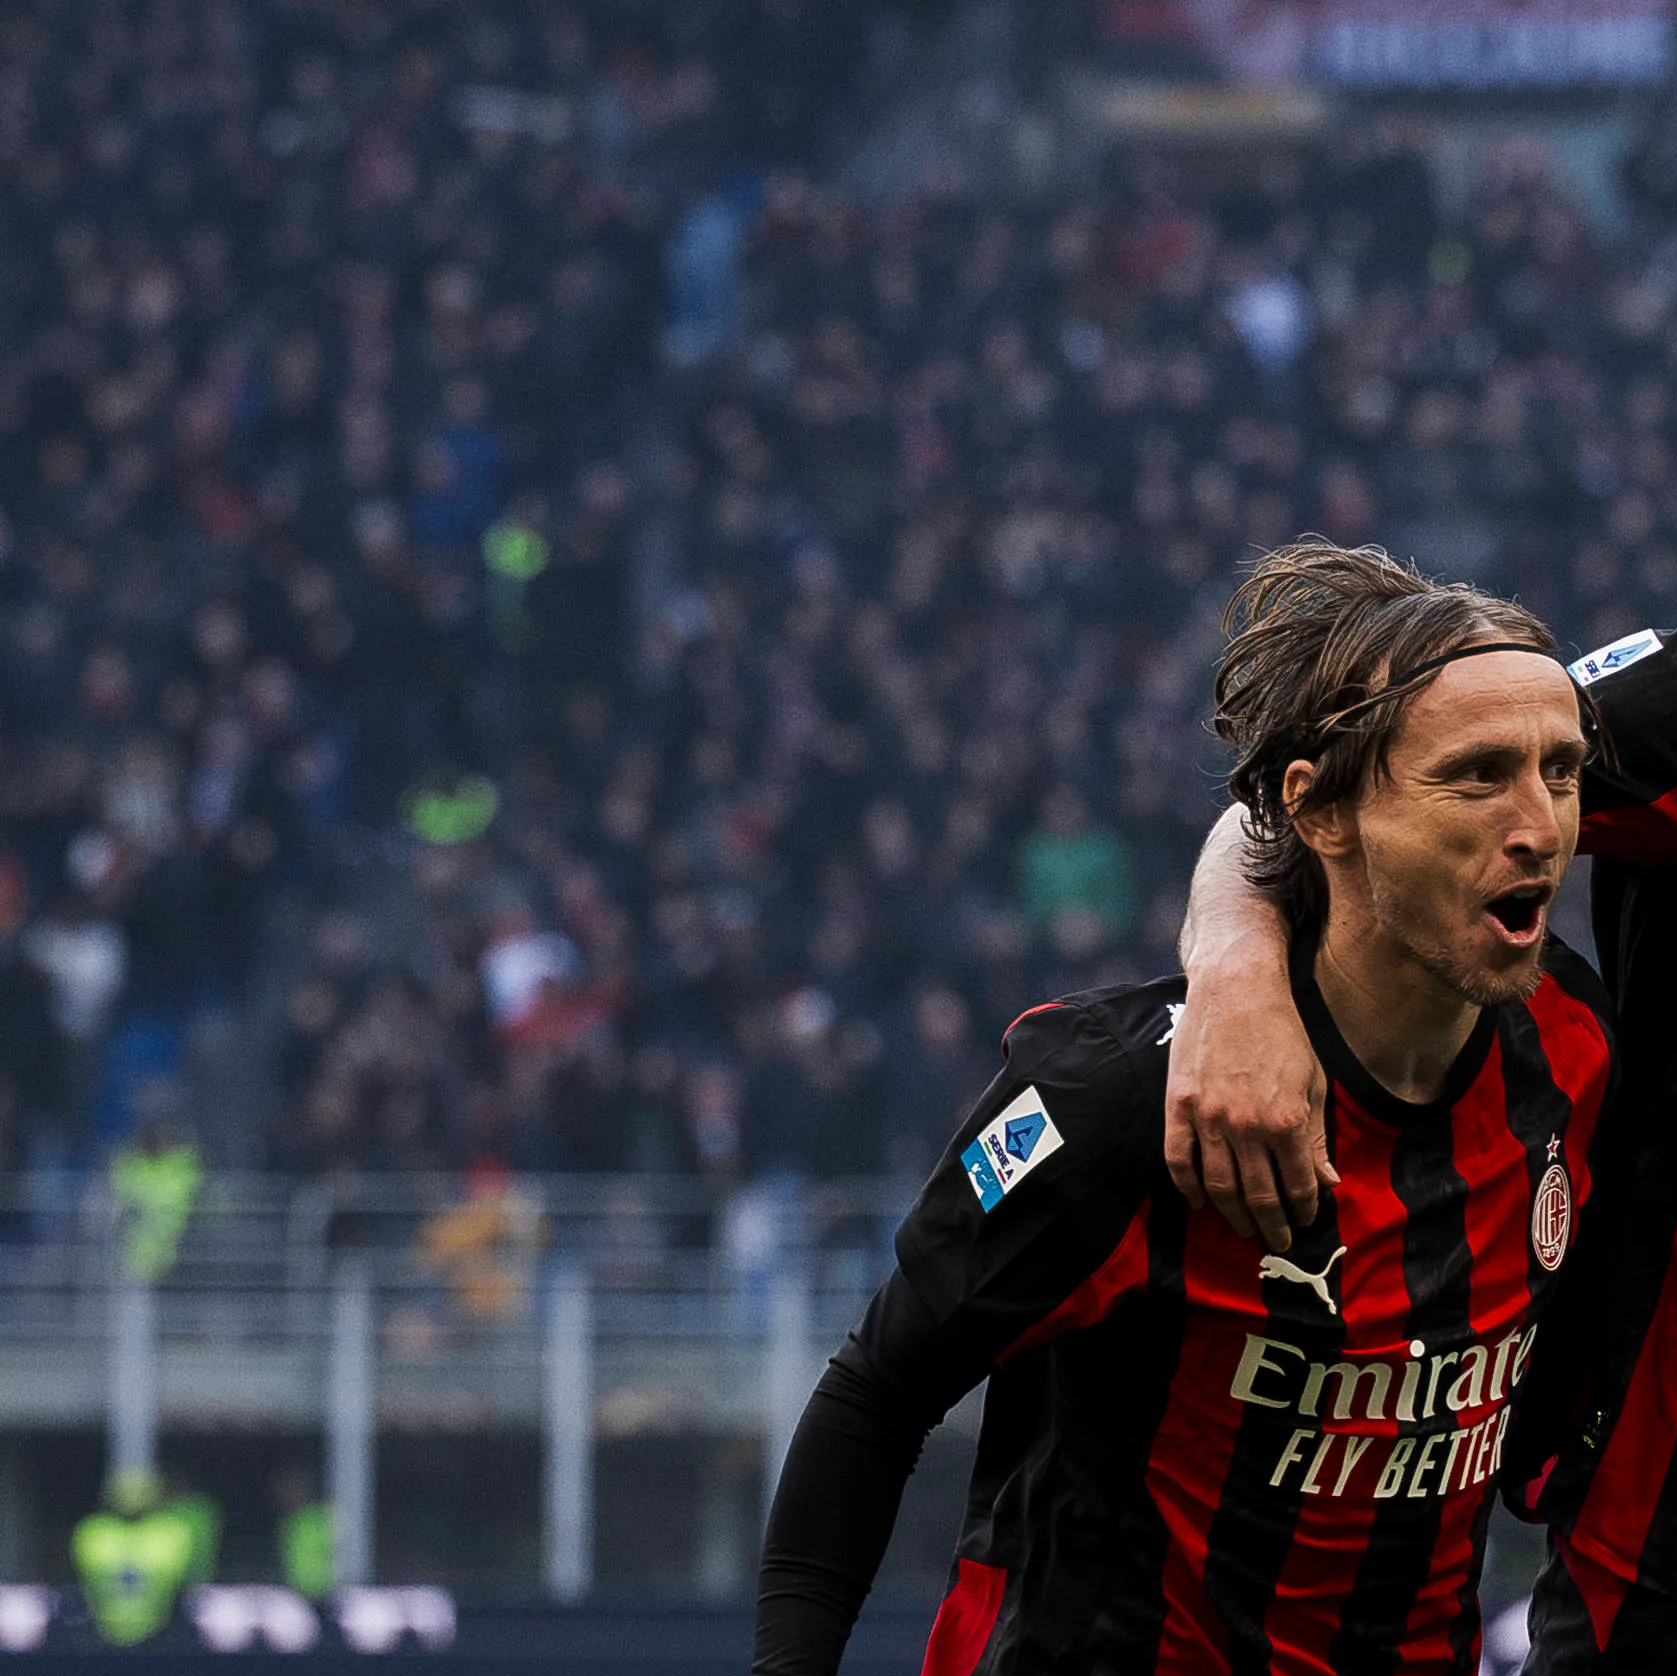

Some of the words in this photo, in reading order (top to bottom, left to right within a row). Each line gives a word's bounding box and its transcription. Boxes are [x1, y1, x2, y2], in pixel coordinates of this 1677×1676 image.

[988, 1134, 1010, 1169] SERIE
[1005, 1169, 1014, 1180] A
[1230, 1323, 1537, 1422] Emirate
[1269, 1428, 1375, 1497] FLY
[1373, 1404, 1512, 1498] BETTER
